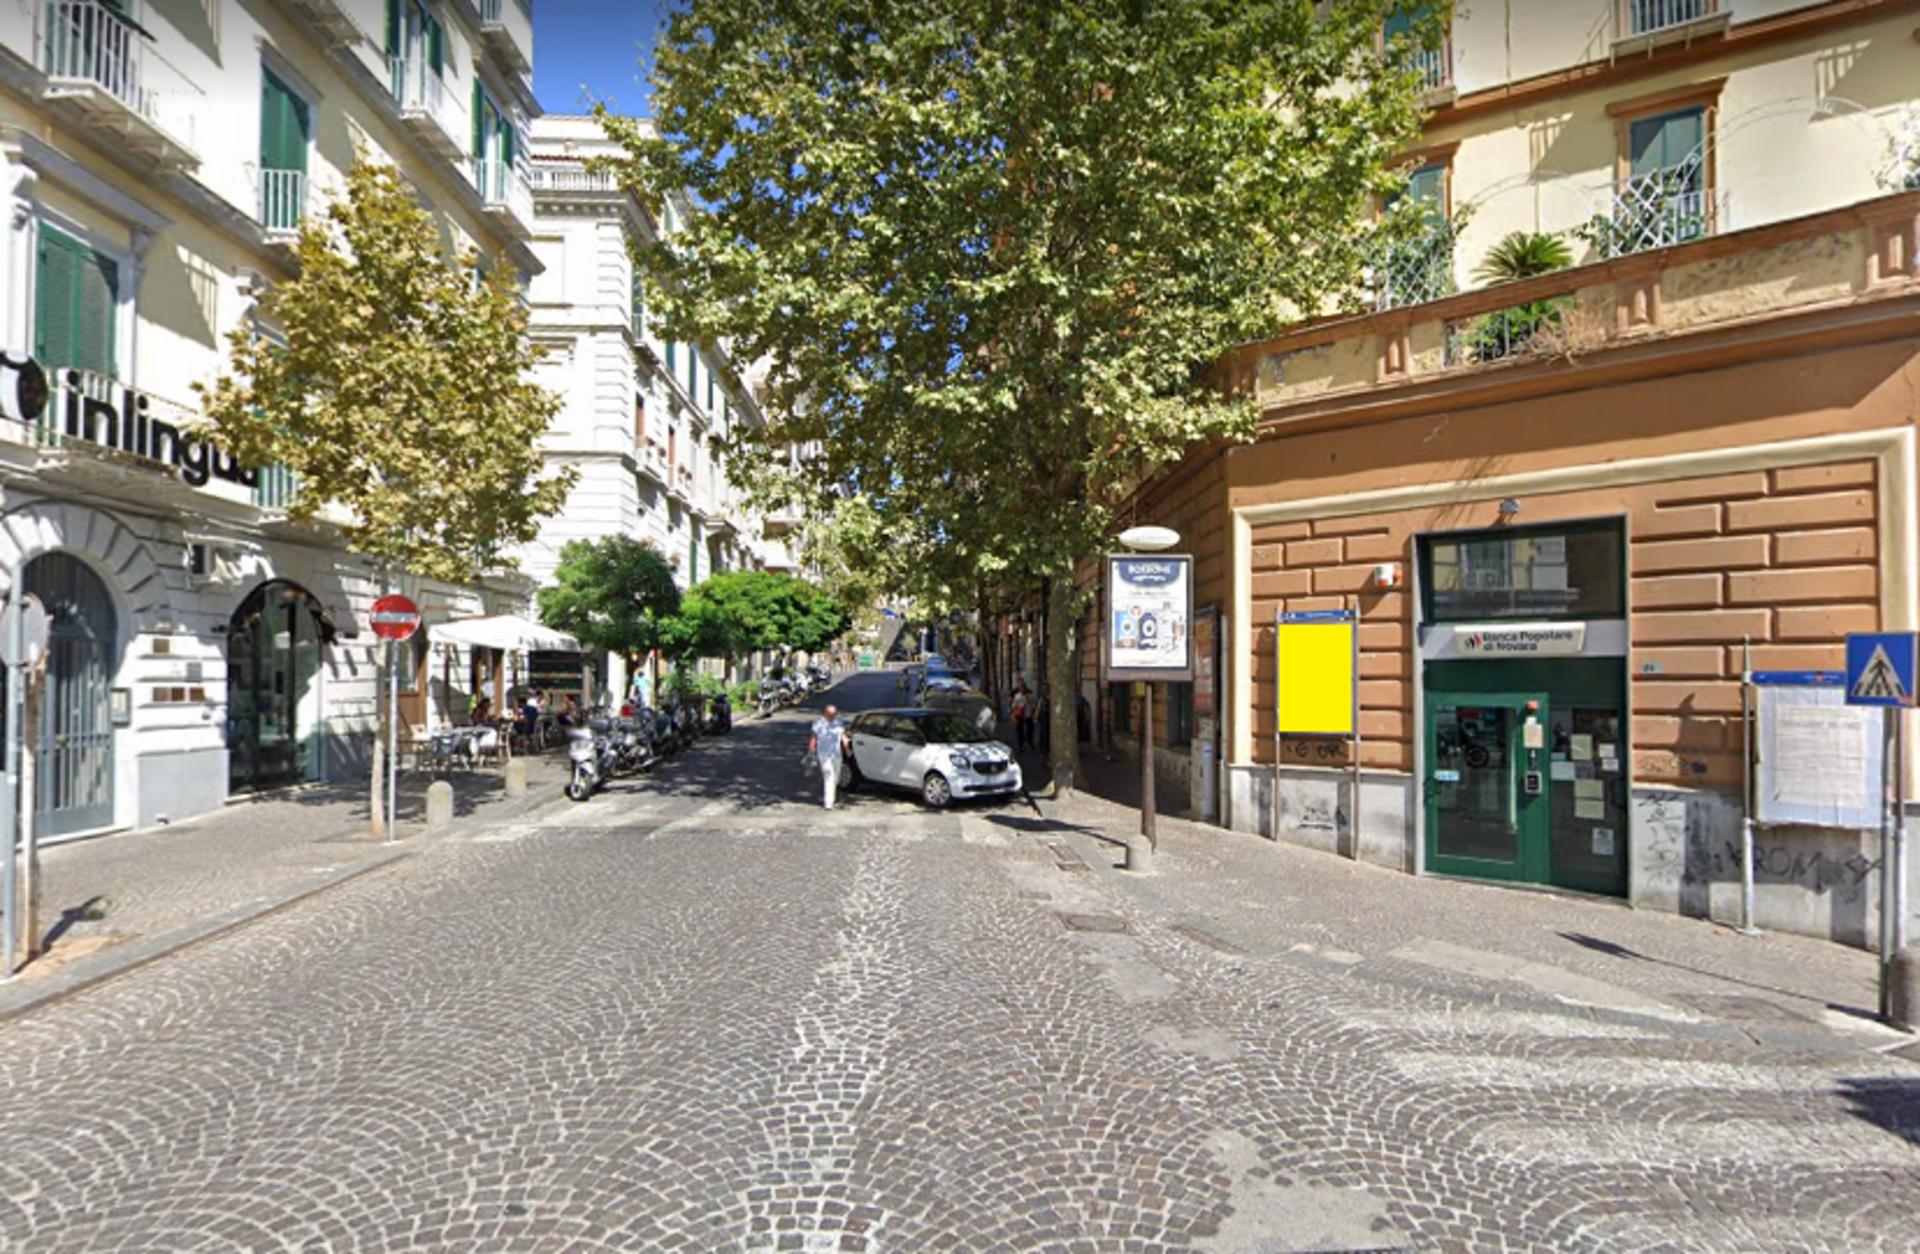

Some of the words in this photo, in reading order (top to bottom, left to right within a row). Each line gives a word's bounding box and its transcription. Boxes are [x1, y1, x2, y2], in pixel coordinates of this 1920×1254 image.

[1483, 632, 1517, 641] Banca
[1520, 630, 1573, 642] Popolare
[1484, 641, 1495, 651] di
[1497, 641, 1538, 651] Novara
